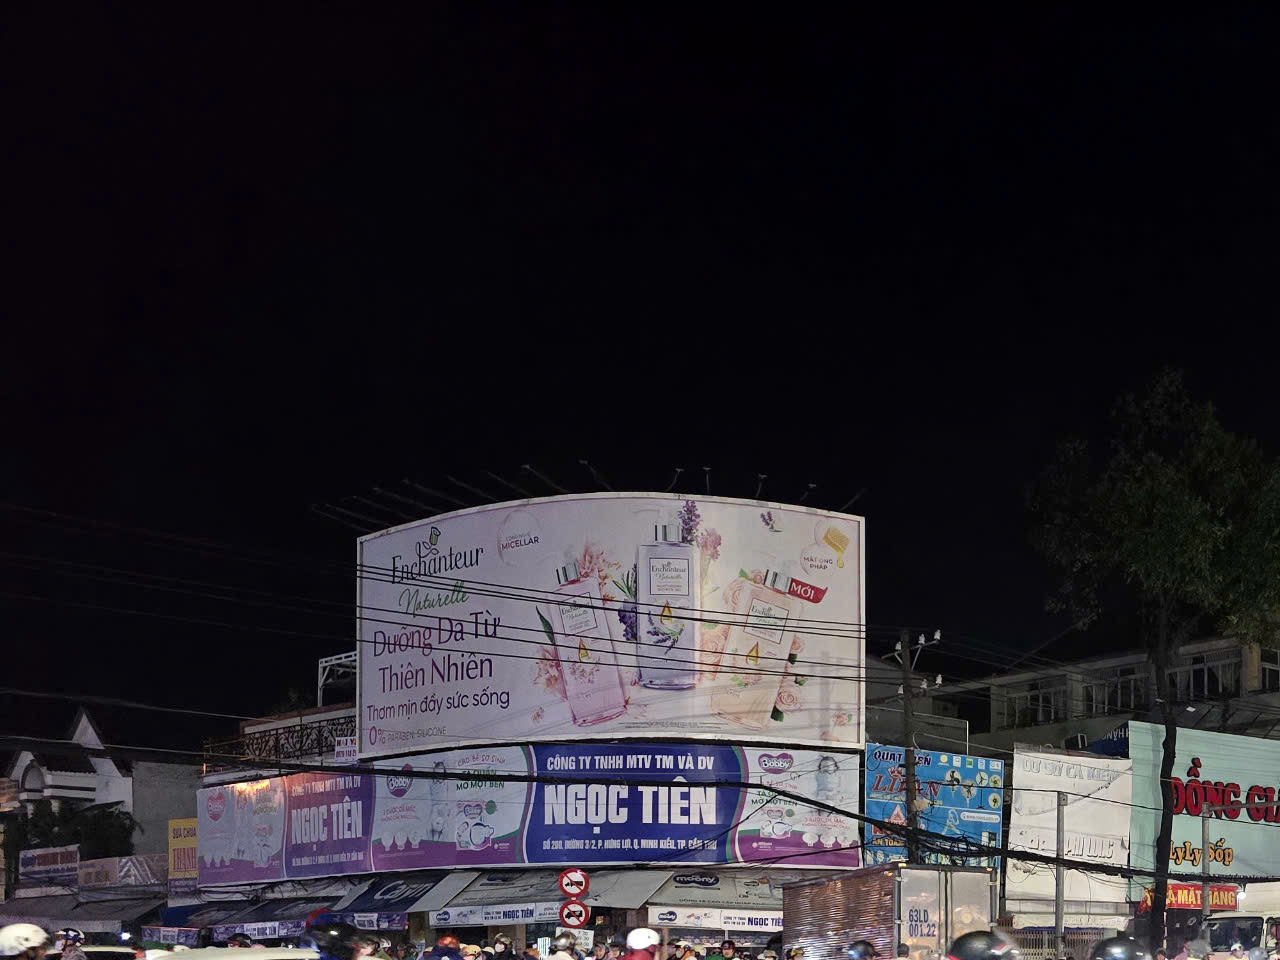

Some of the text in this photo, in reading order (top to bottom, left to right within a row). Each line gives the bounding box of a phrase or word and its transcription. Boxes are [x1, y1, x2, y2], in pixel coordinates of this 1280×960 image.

[501, 536, 539, 550] MICELLAR
[391, 542, 484, 585] Enchanteur
[399, 581, 469, 617] Naturelle
[790, 582, 815, 599] MỚI
[373, 610, 500, 657] Dưỡng Da Từ
[379, 653, 493, 693] Thiên Nhiên
[367, 686, 510, 721] Thơm mịn đầy sức sống
[368, 726, 386, 746] 0%
[547, 752, 715, 770] CÔNG TY TNHH MTV TM VÀ DV
[762, 758, 792, 769] Bobby
[544, 776, 717, 834] NGỌC TIÊN
[291, 795, 363, 851] NGỌC TIÊN
[502, 909, 520, 921] NGỌC
[520, 907, 534, 919] TIÊN
[747, 917, 768, 928] NGỌC
[908, 909, 929, 923] 63LD
[908, 923, 936, 937] 001.22
